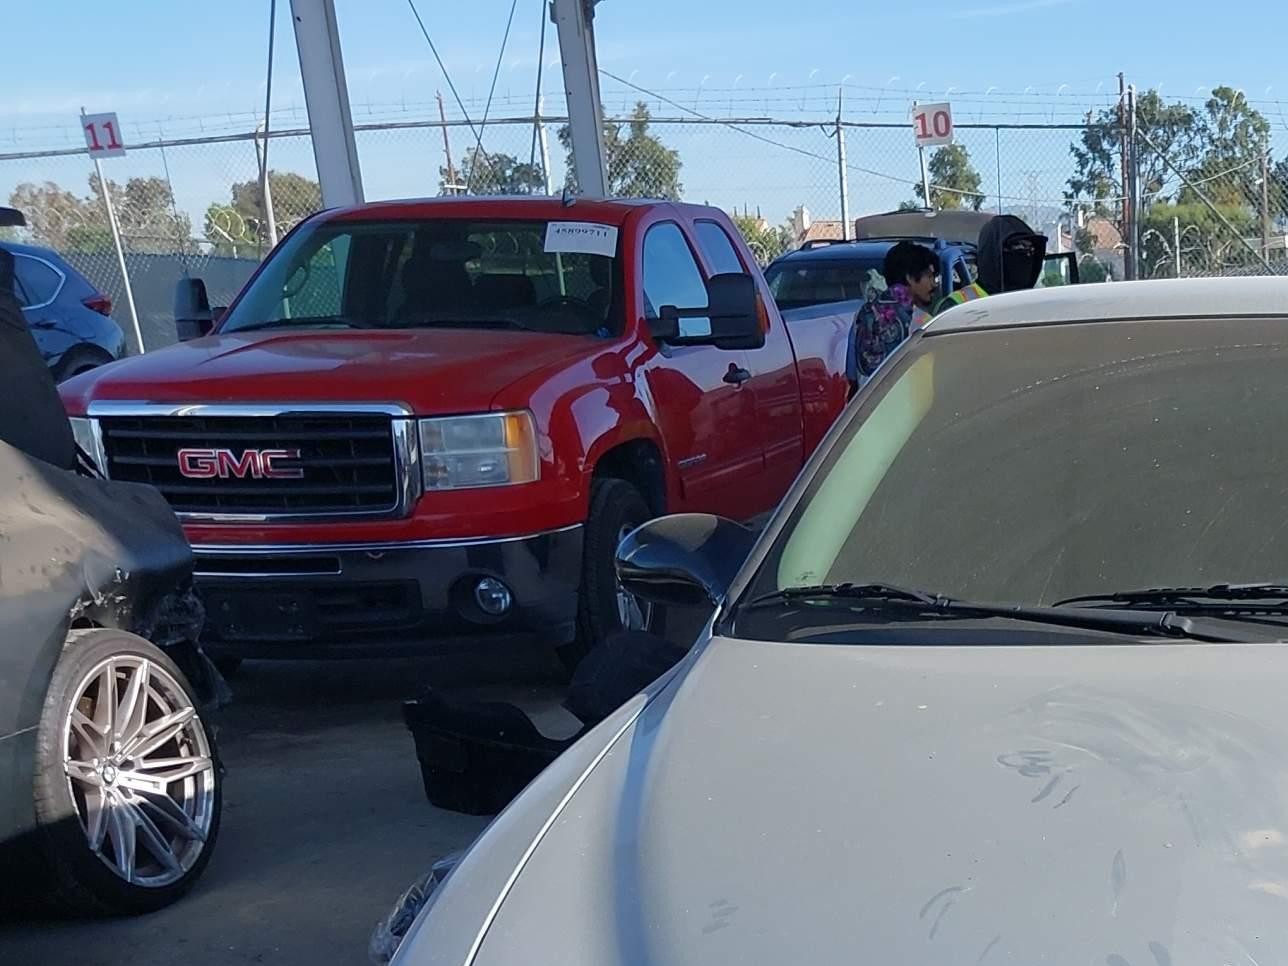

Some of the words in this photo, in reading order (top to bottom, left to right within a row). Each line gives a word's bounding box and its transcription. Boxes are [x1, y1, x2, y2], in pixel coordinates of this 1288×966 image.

[85, 121, 123, 151] 11
[914, 110, 951, 139] 10
[177, 448, 304, 479] GMC
